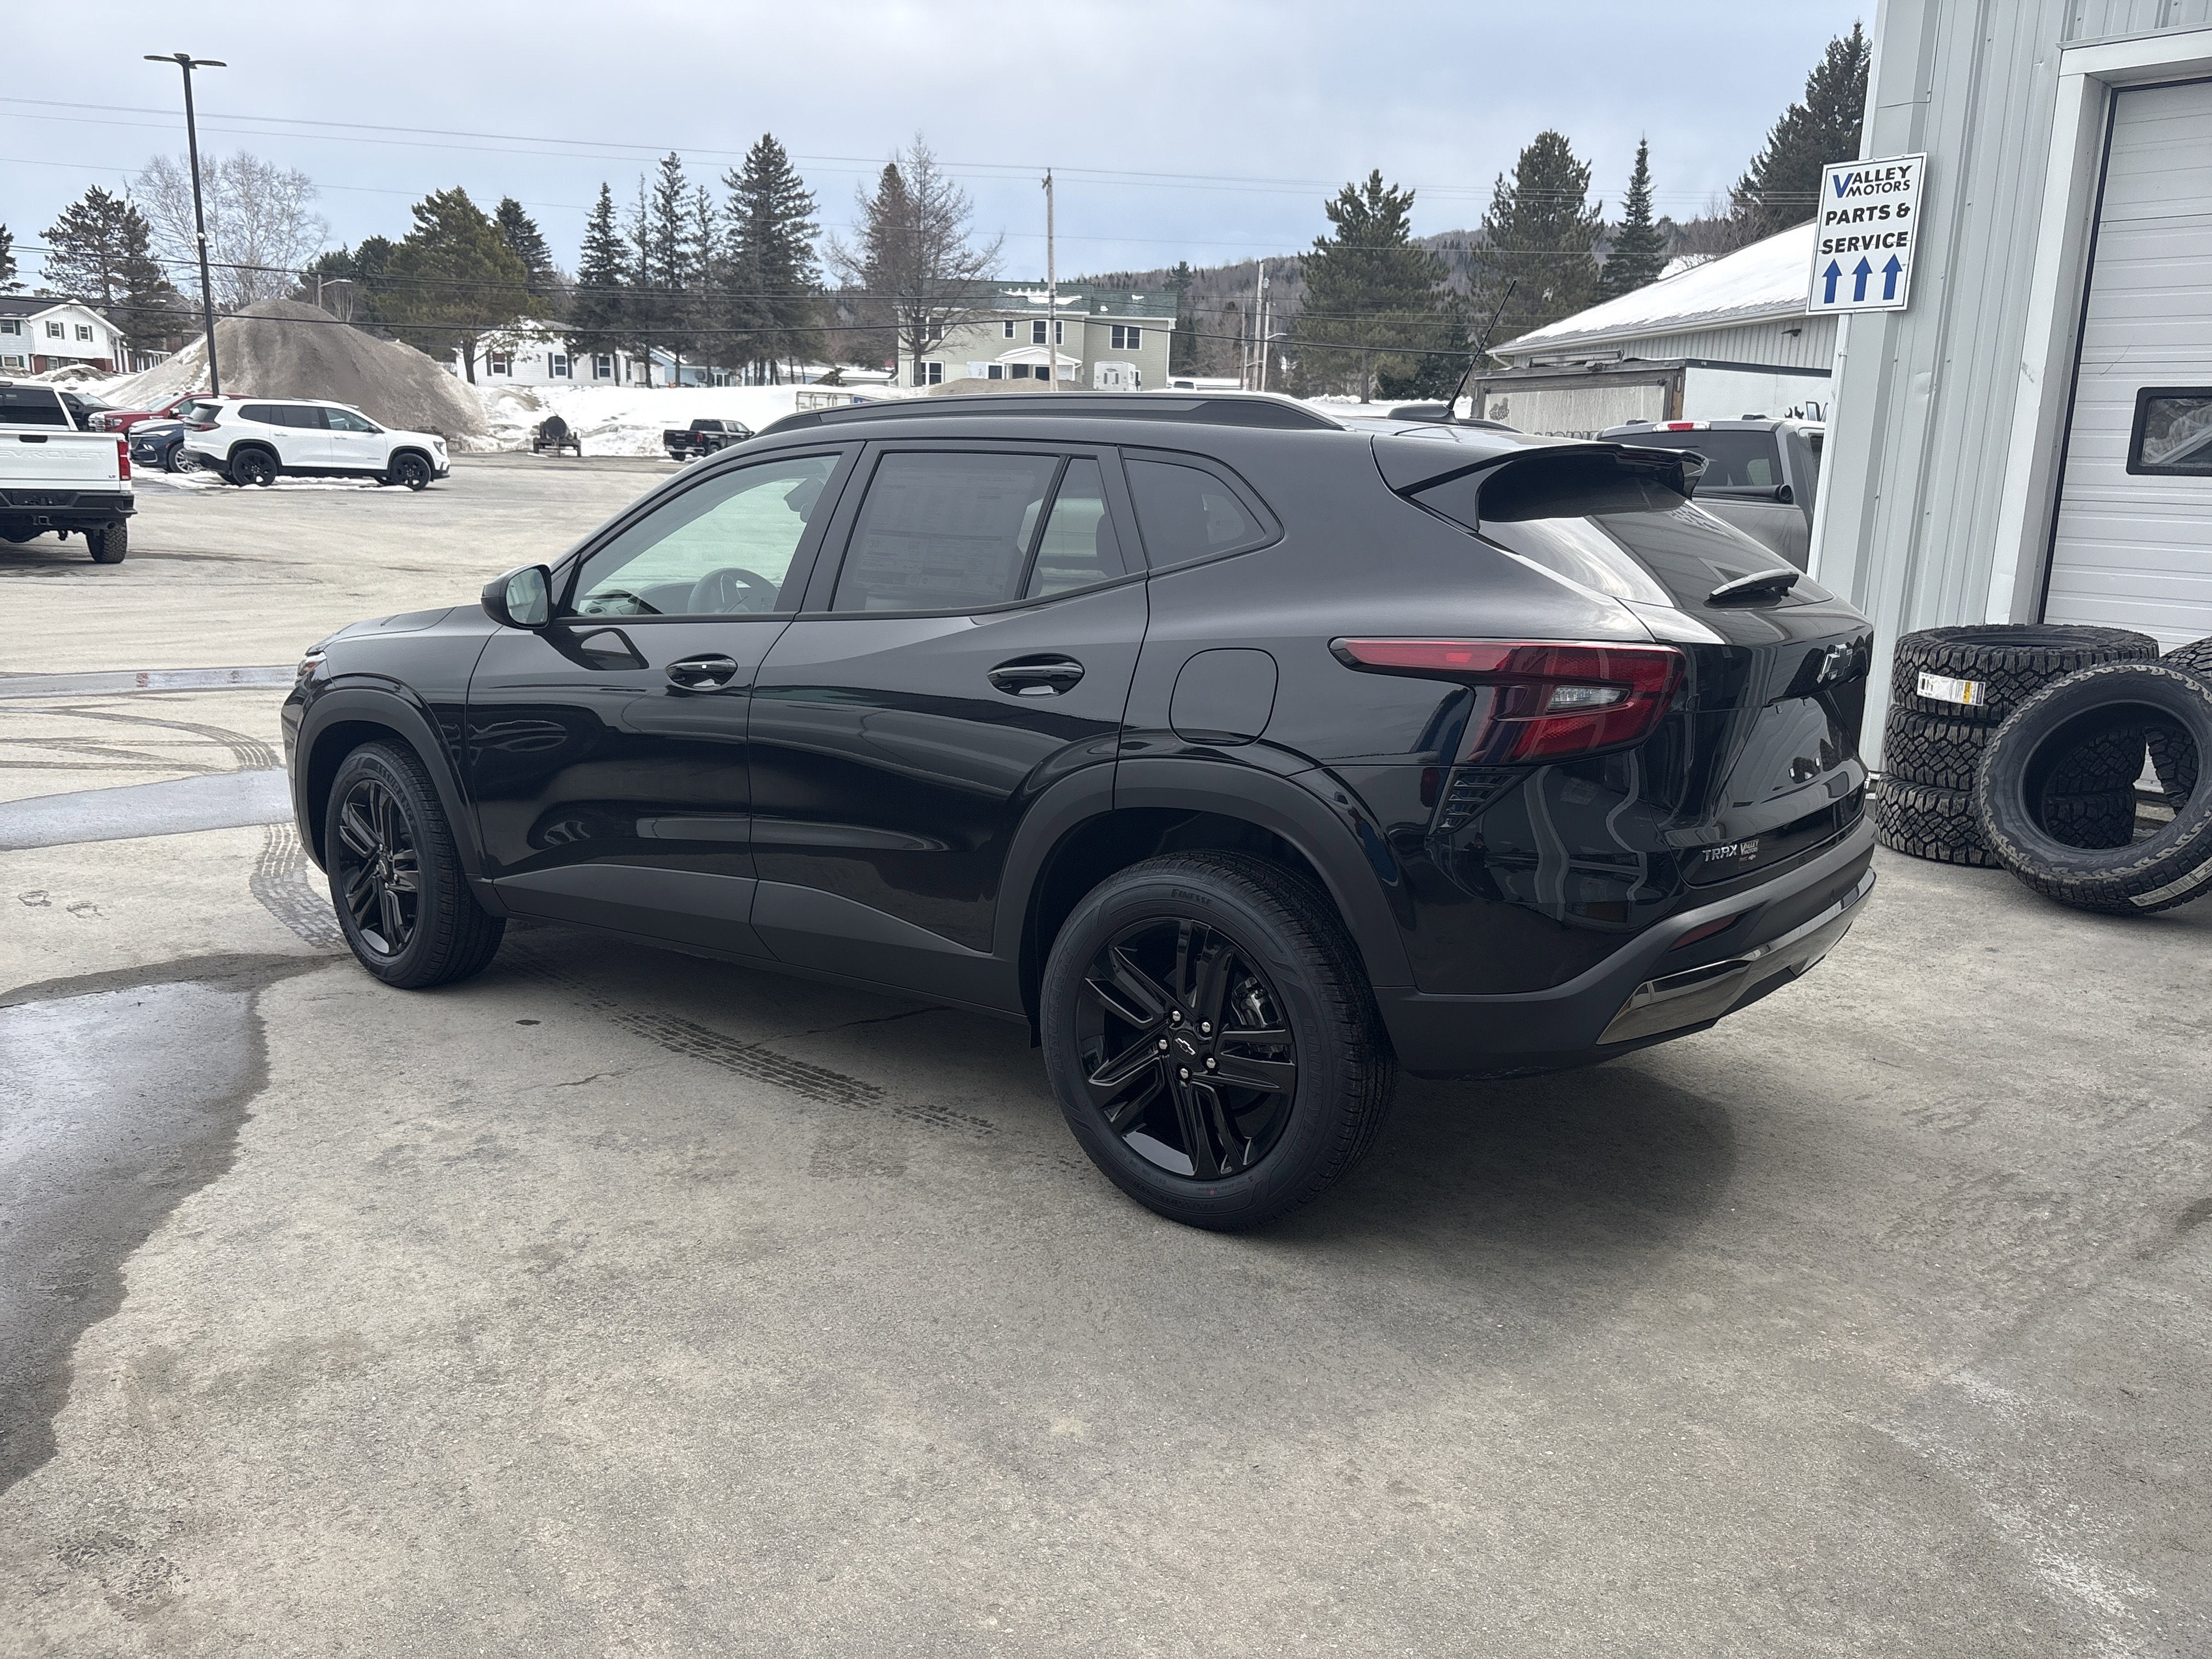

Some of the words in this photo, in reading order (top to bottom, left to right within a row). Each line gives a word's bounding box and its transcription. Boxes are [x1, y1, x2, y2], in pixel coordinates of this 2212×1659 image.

[1832, 165, 1913, 198] VALLEY
[1846, 179, 1910, 198] MOTORS
[1825, 204, 1891, 226] PARTS
[1896, 202, 1911, 218] &
[1821, 231, 1909, 255] SERVICE
[1702, 844, 1737, 862] TRAX
